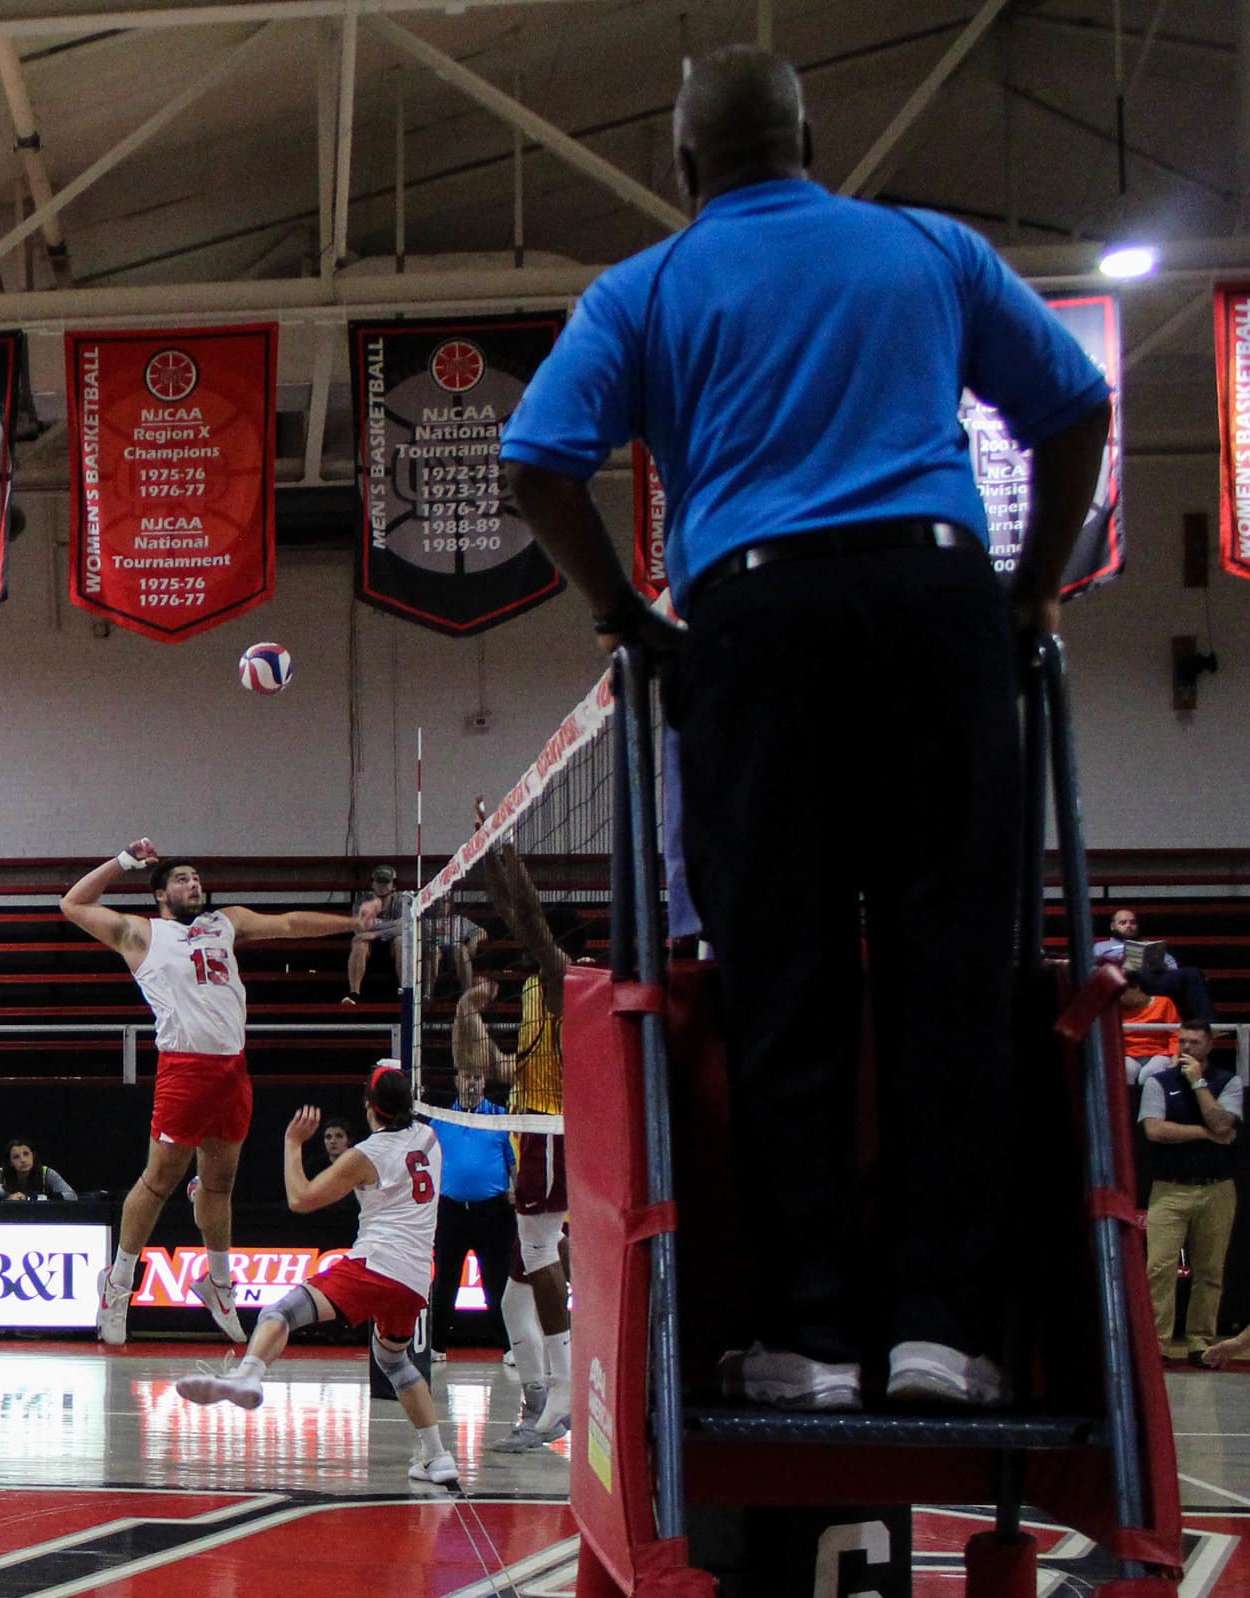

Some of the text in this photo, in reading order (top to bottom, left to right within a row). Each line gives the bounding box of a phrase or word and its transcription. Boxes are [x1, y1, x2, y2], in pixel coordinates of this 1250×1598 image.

[141, 408, 202, 421] NJCAA
[423, 405, 496, 421] NJCAA
[133, 426, 210, 443] Region X
[415, 422, 504, 441] National
[368, 337, 387, 549] MEN'S BASKETBALL
[396, 441, 500, 459] Tourname
[123, 446, 220, 462] Champions
[84, 347, 102, 593] WOMEN'S BASKETBALL
[139, 468, 206, 481] 1975-76
[422, 465, 500, 481] 1972-73
[987, 465, 1025, 479] NCA
[139, 484, 206, 497] 1976-77
[422, 483, 500, 498] 1973-74
[422, 502, 500, 517] 1976-77
[141, 517, 202, 530] NJCAA
[422, 519, 500, 534] 1988-89
[134, 535, 209, 549] National
[422, 537, 500, 552] 1989-90
[139, 578, 206, 591] 1975-76
[139, 594, 206, 607] 1976-77
[190, 948, 229, 985] 15
[405, 1150, 435, 1204] 6
